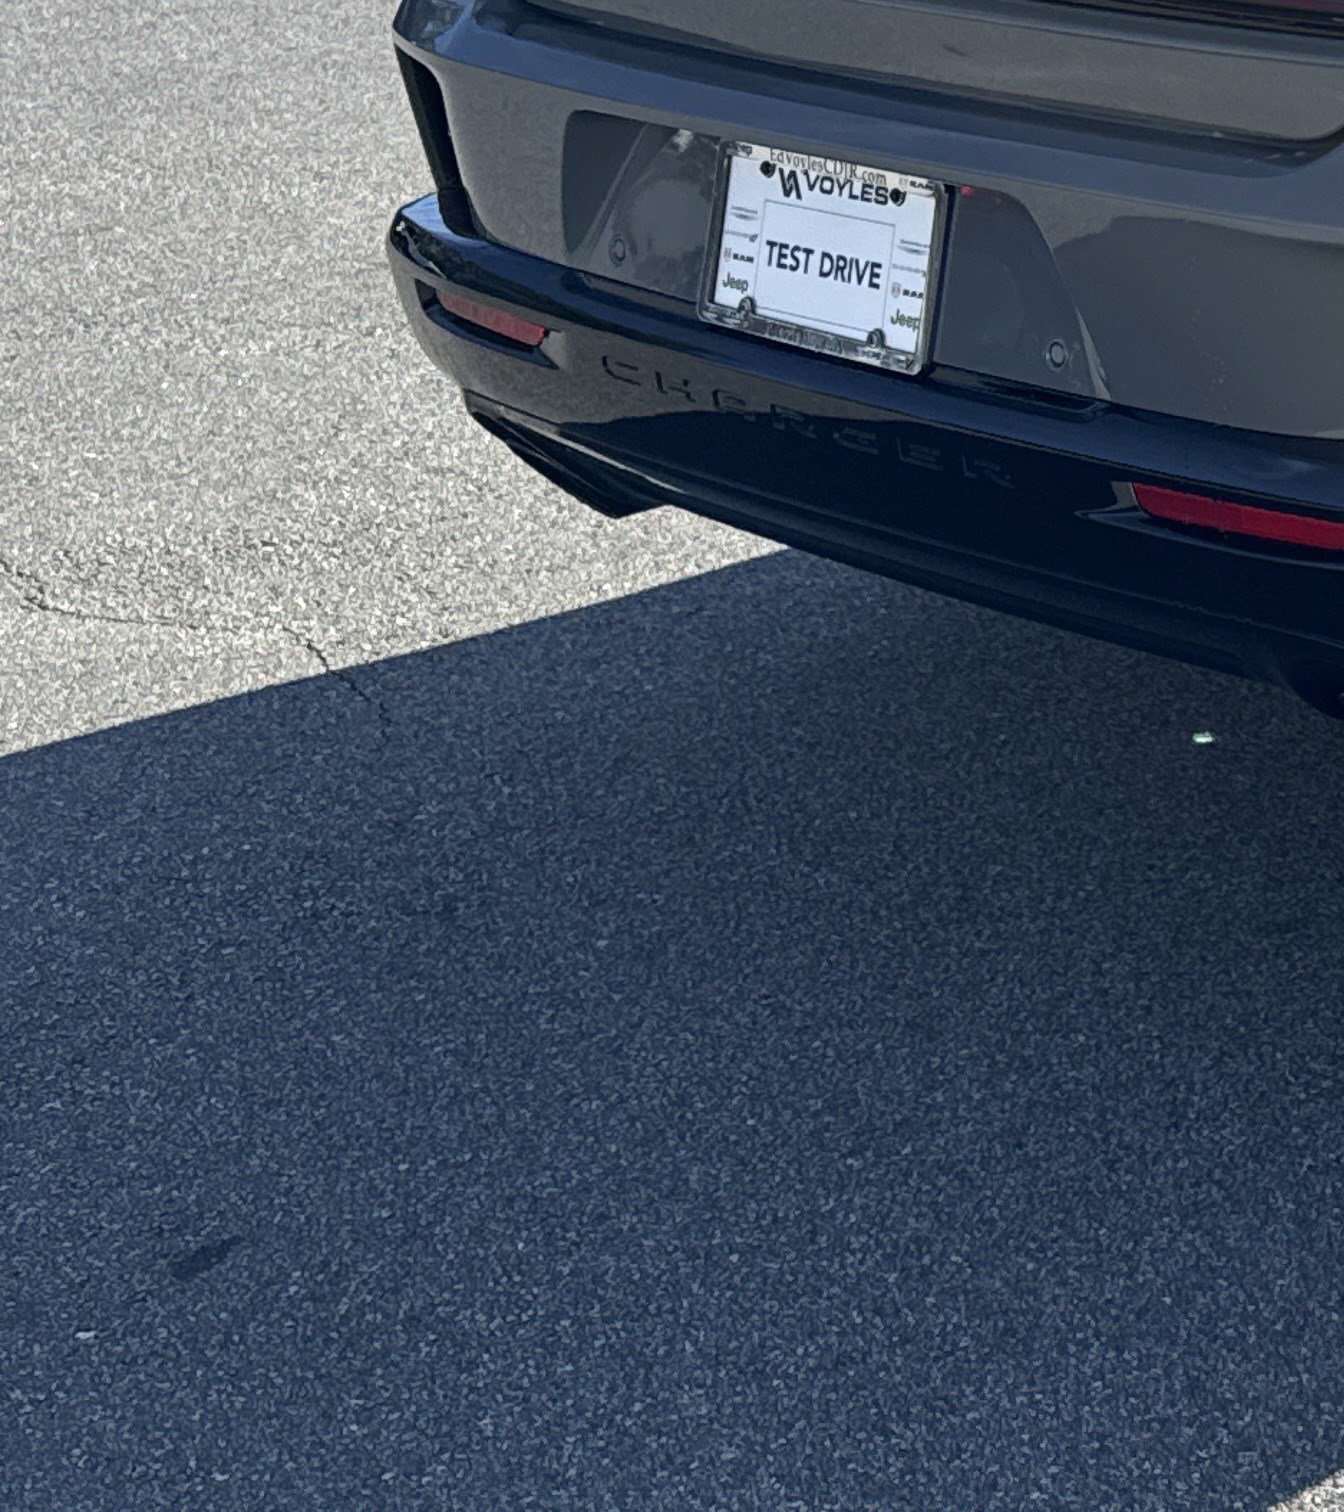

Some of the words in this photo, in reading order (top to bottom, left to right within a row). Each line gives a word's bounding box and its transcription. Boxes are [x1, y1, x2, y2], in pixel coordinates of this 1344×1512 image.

[803, 170, 889, 206] VOYLES
[765, 239, 815, 275] TEST
[819, 251, 882, 290] DRIVE
[602, 354, 1016, 489] CHARGER
